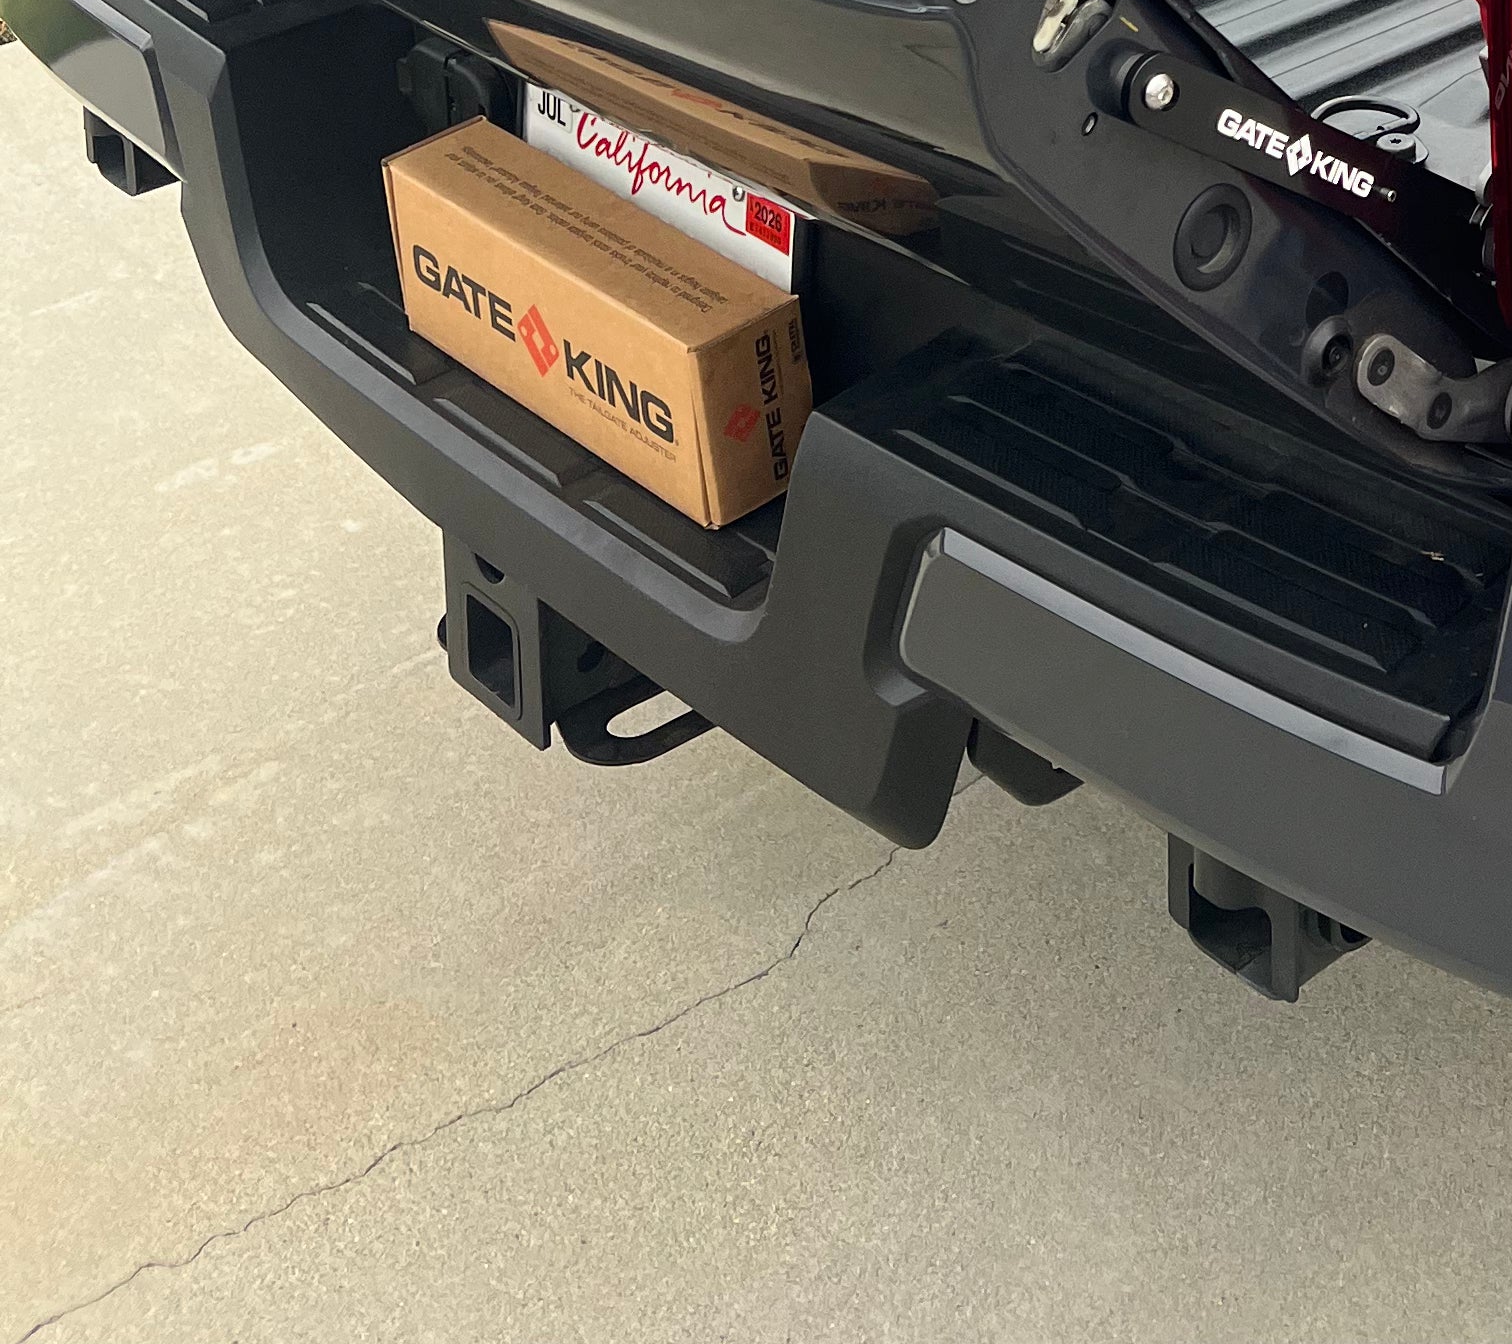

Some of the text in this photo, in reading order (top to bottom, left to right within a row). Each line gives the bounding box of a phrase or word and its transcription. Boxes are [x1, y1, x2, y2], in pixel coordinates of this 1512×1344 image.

[537, 91, 567, 127] JUL
[576, 111, 747, 236] California
[1217, 108, 1376, 199] GATE KING
[754, 201, 783, 233] 2026
[413, 245, 516, 342] GATE
[563, 339, 676, 444] KING
[766, 407, 790, 481] GATE
